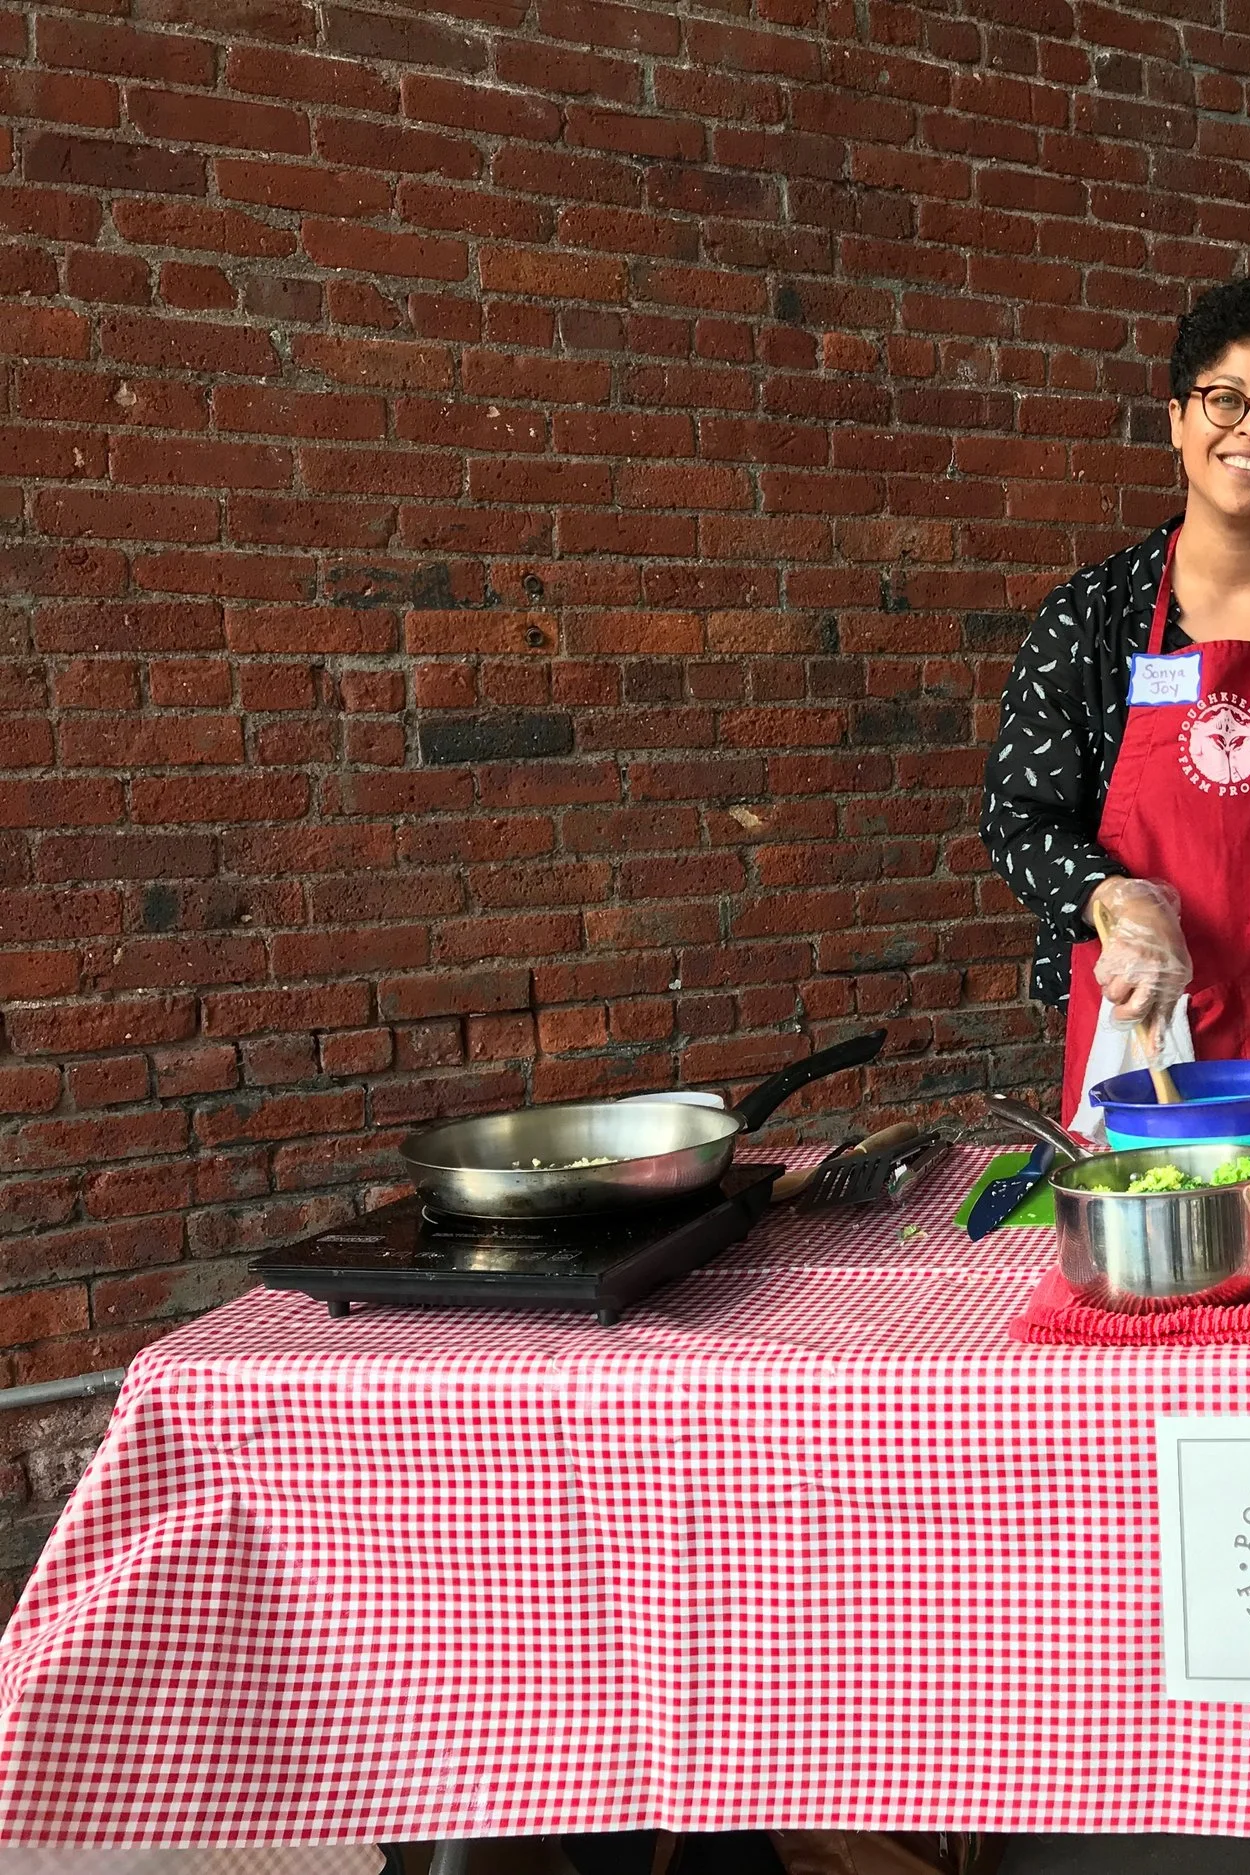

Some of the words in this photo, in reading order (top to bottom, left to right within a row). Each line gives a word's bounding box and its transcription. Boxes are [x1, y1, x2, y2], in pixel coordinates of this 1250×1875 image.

[1142, 664, 1186, 683] Sonya
[1149, 682, 1179, 698] Joy
[1178, 756, 1211, 794] FARM
